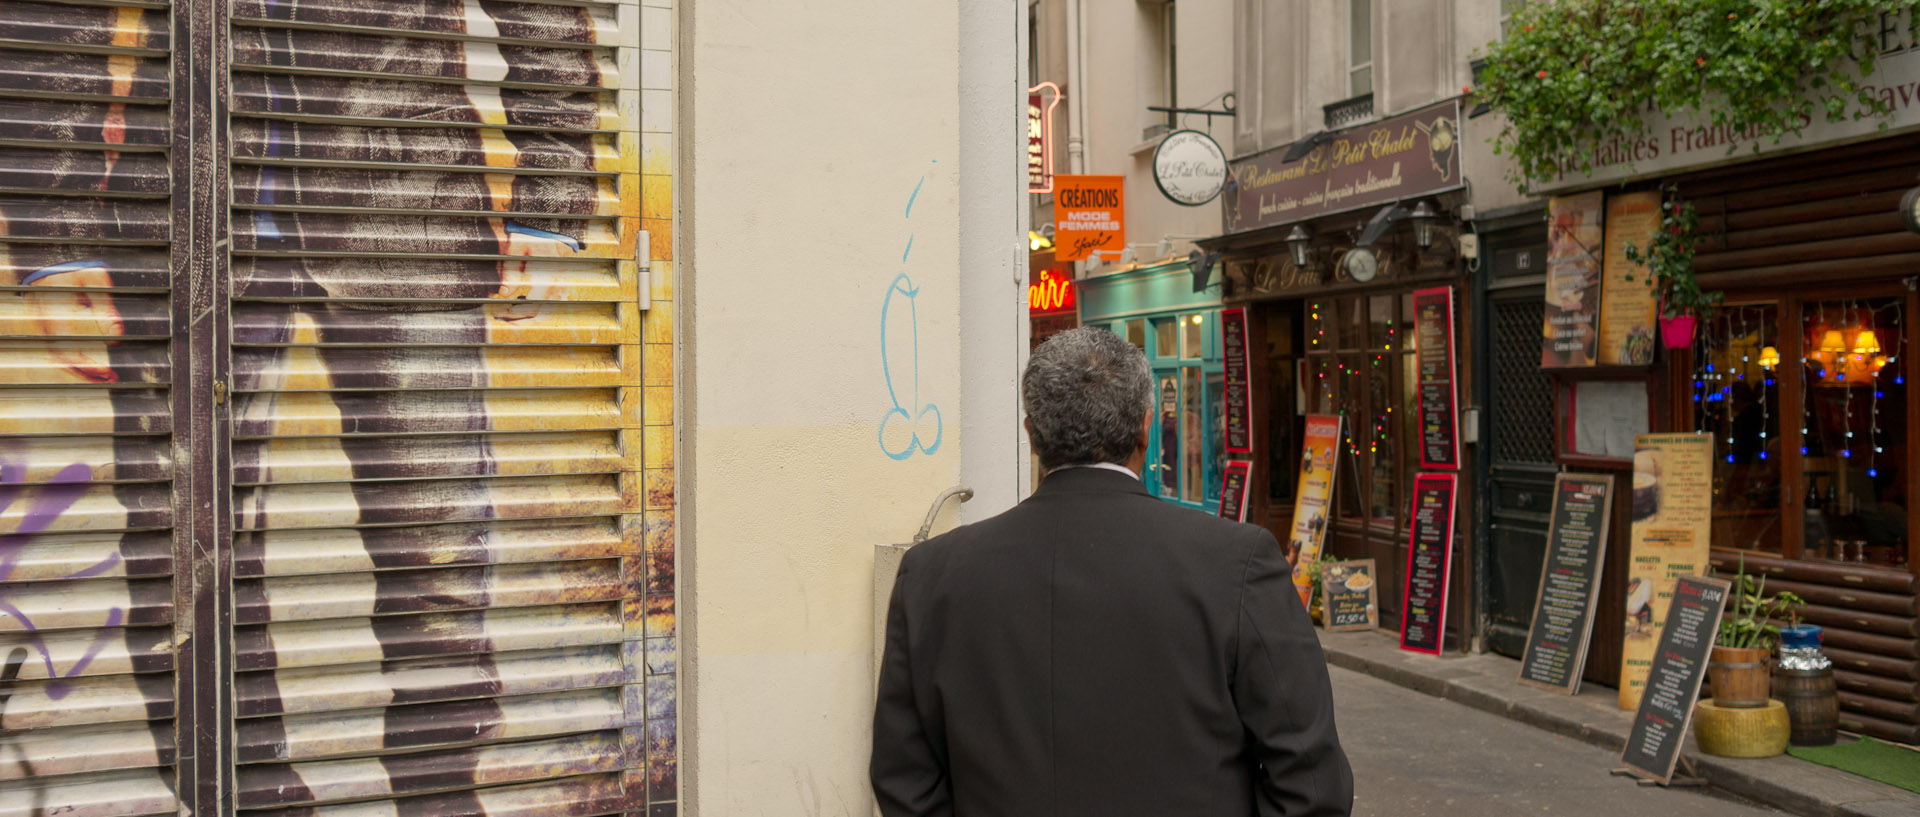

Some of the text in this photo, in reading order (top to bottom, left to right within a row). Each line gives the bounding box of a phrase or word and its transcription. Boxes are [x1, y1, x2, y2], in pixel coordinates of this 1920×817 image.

[1243, 125, 1417, 191] Restaurant Le Petit Chalet
[1060, 184, 1118, 208] CRÉATIONS
[1258, 193, 1277, 222] french
[1354, 161, 1401, 194] traditionnelle
[1059, 221, 1120, 231] FEMMES
[1068, 211, 1110, 221] MODE
[1253, 261, 1277, 294] Le
[1336, 614, 1359, 624] 12.50
